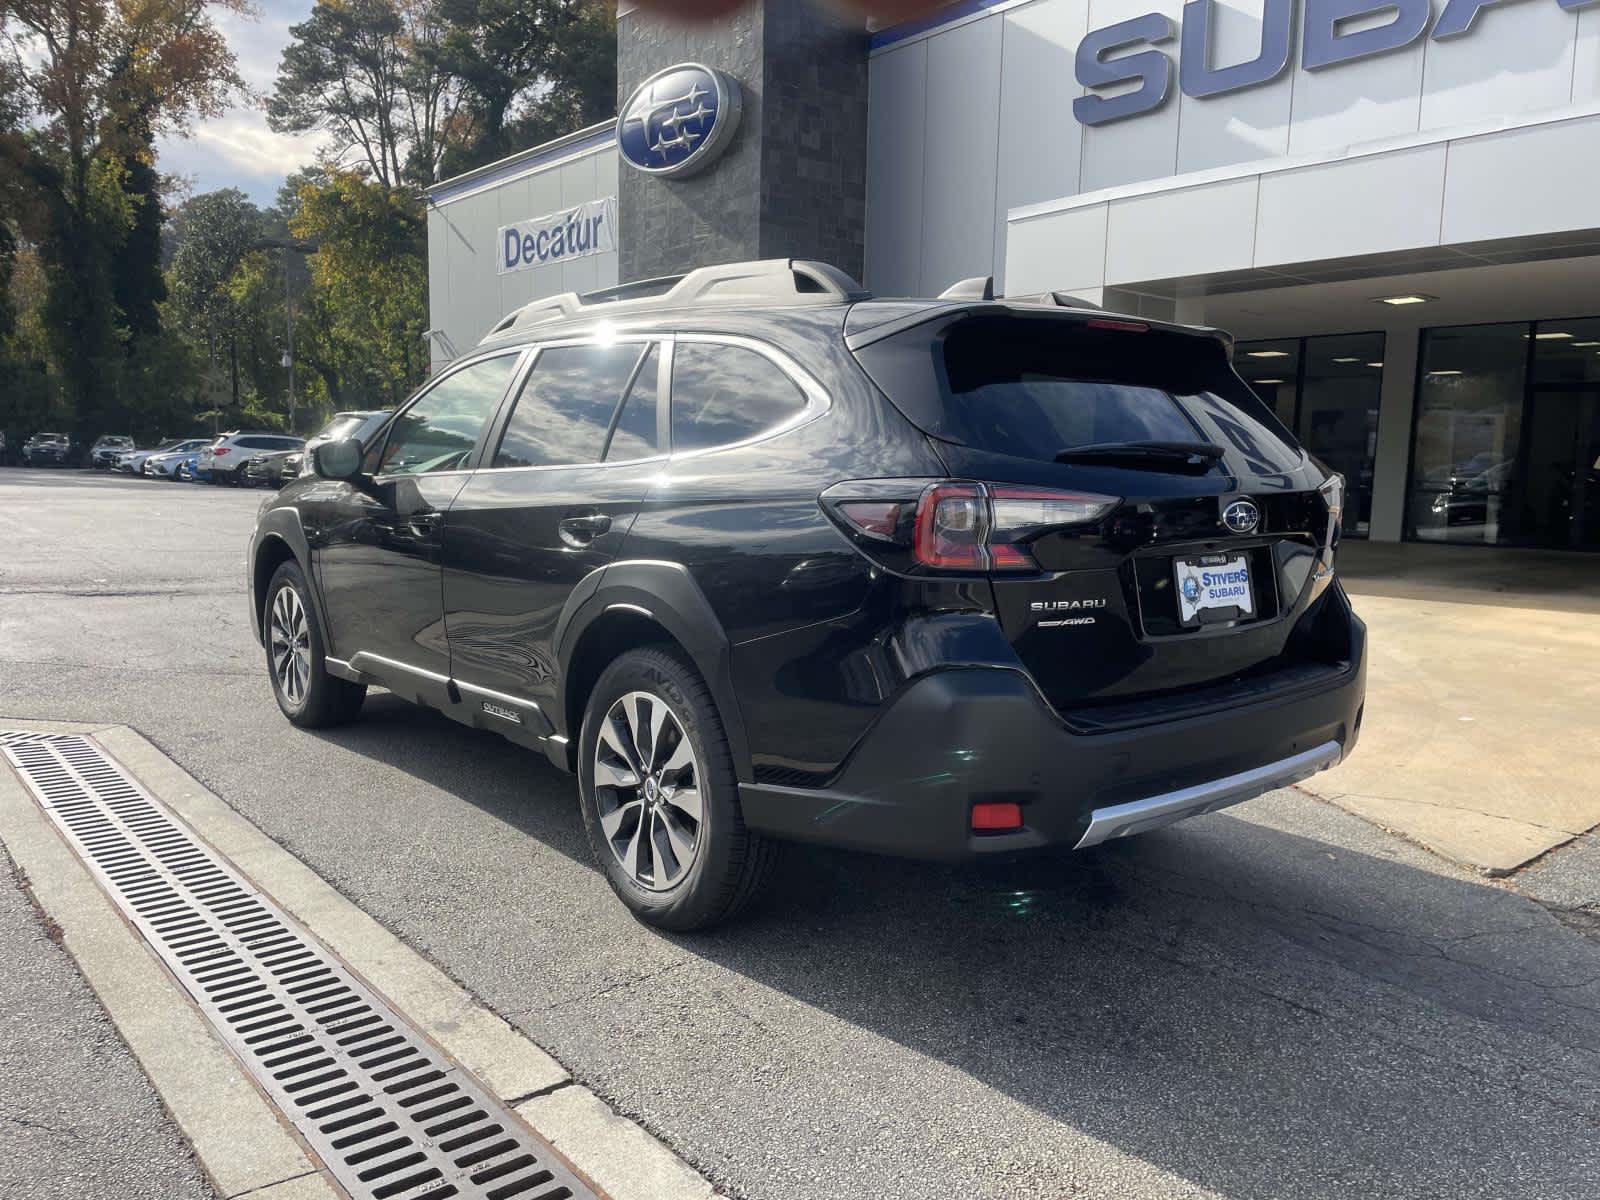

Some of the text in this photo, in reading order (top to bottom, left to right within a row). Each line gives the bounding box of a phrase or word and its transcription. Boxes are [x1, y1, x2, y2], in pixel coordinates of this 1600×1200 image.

[504, 214, 603, 268] Decatur
[1202, 569, 1248, 587] STIVERS
[1209, 586, 1245, 599] SUBARU
[1030, 599, 1106, 611] SUBARU
[1061, 617, 1096, 626] AWD
